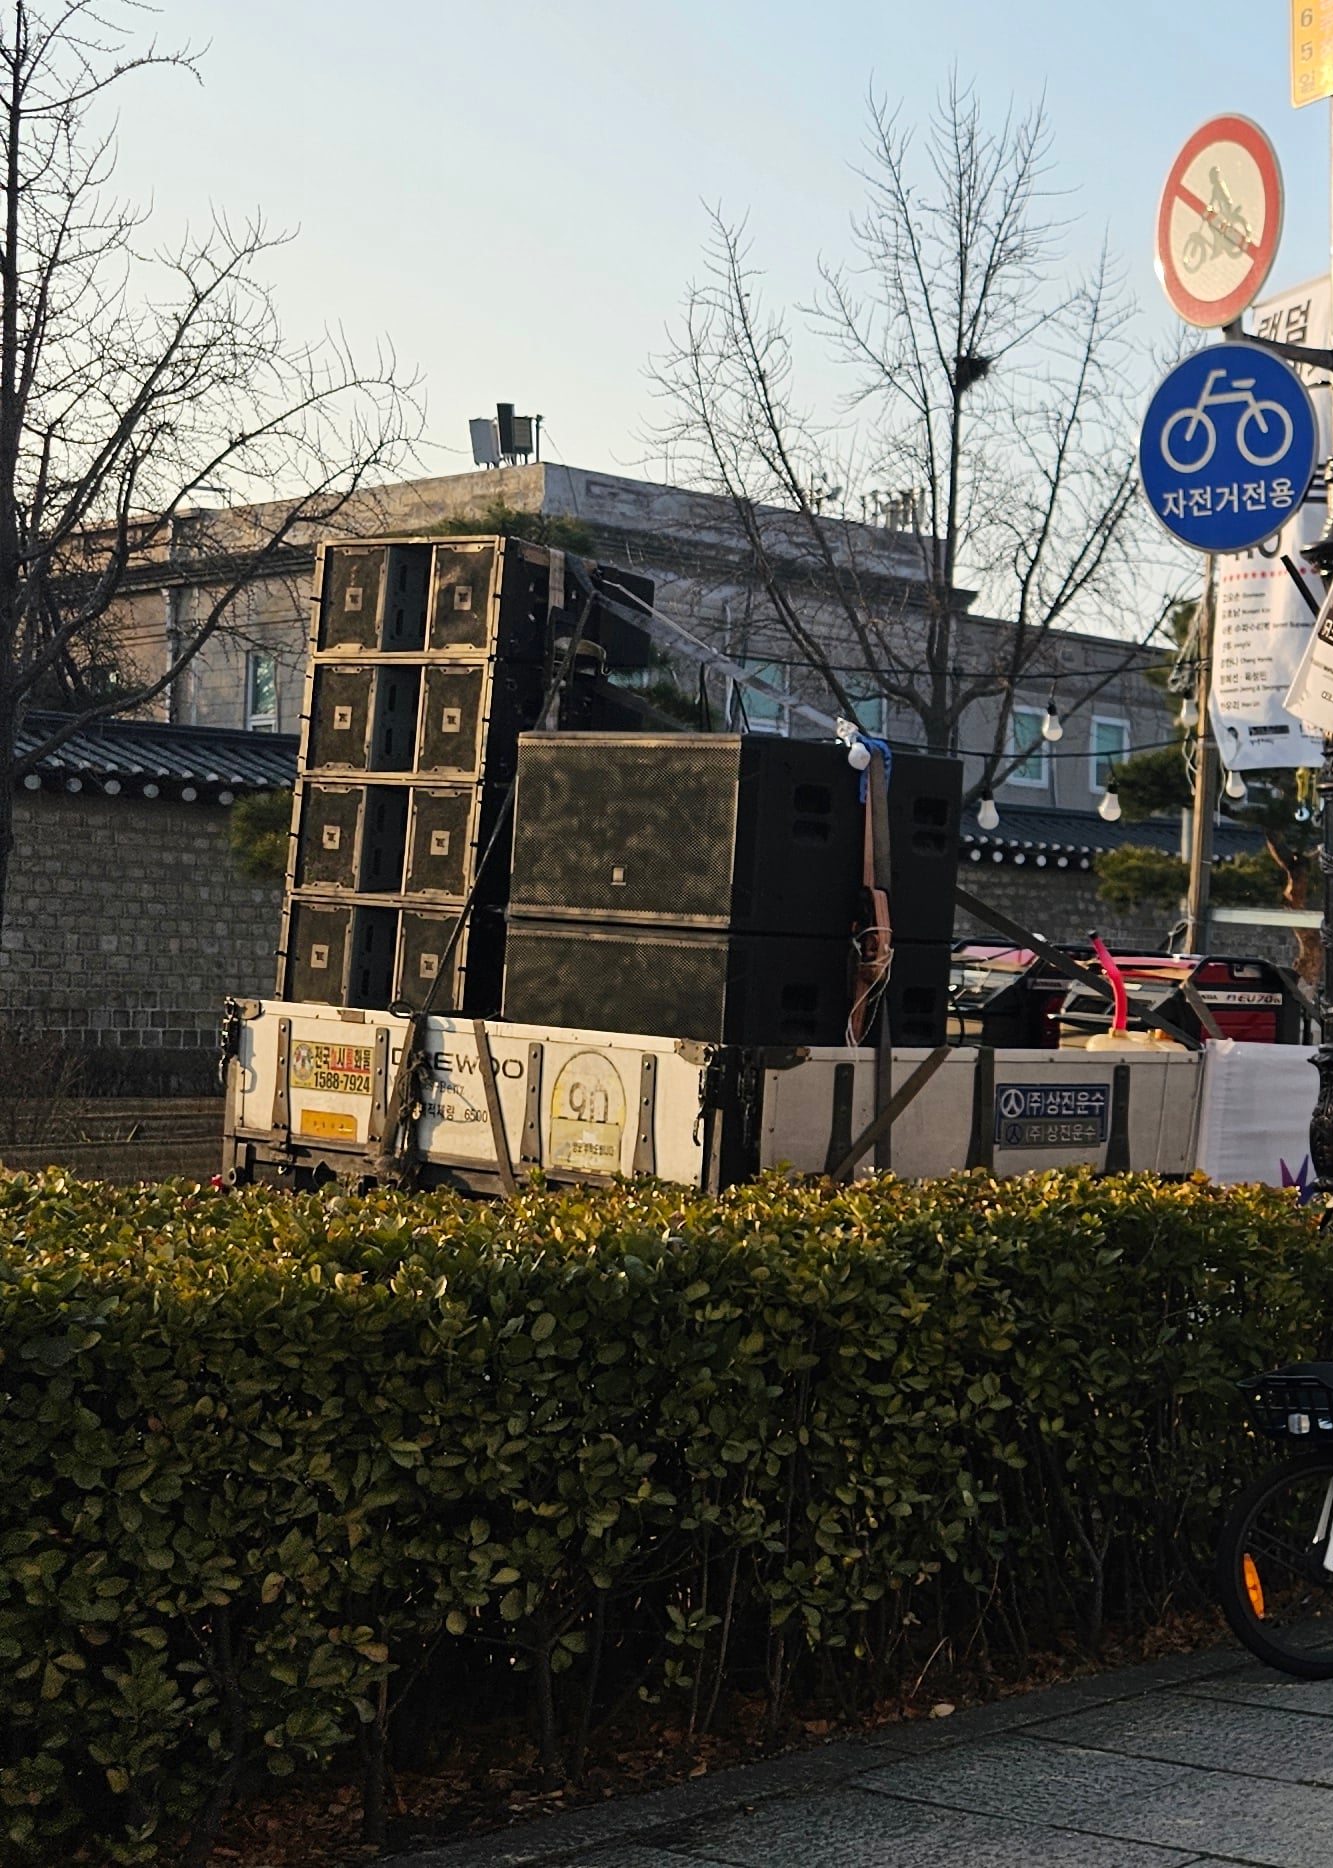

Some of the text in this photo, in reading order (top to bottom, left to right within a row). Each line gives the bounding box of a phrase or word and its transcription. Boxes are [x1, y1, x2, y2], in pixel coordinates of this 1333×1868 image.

[1162, 477, 1296, 519] 자전거전용
[391, 1047, 525, 1080] DEWO
[313, 1070, 371, 1093] 1588-7924
